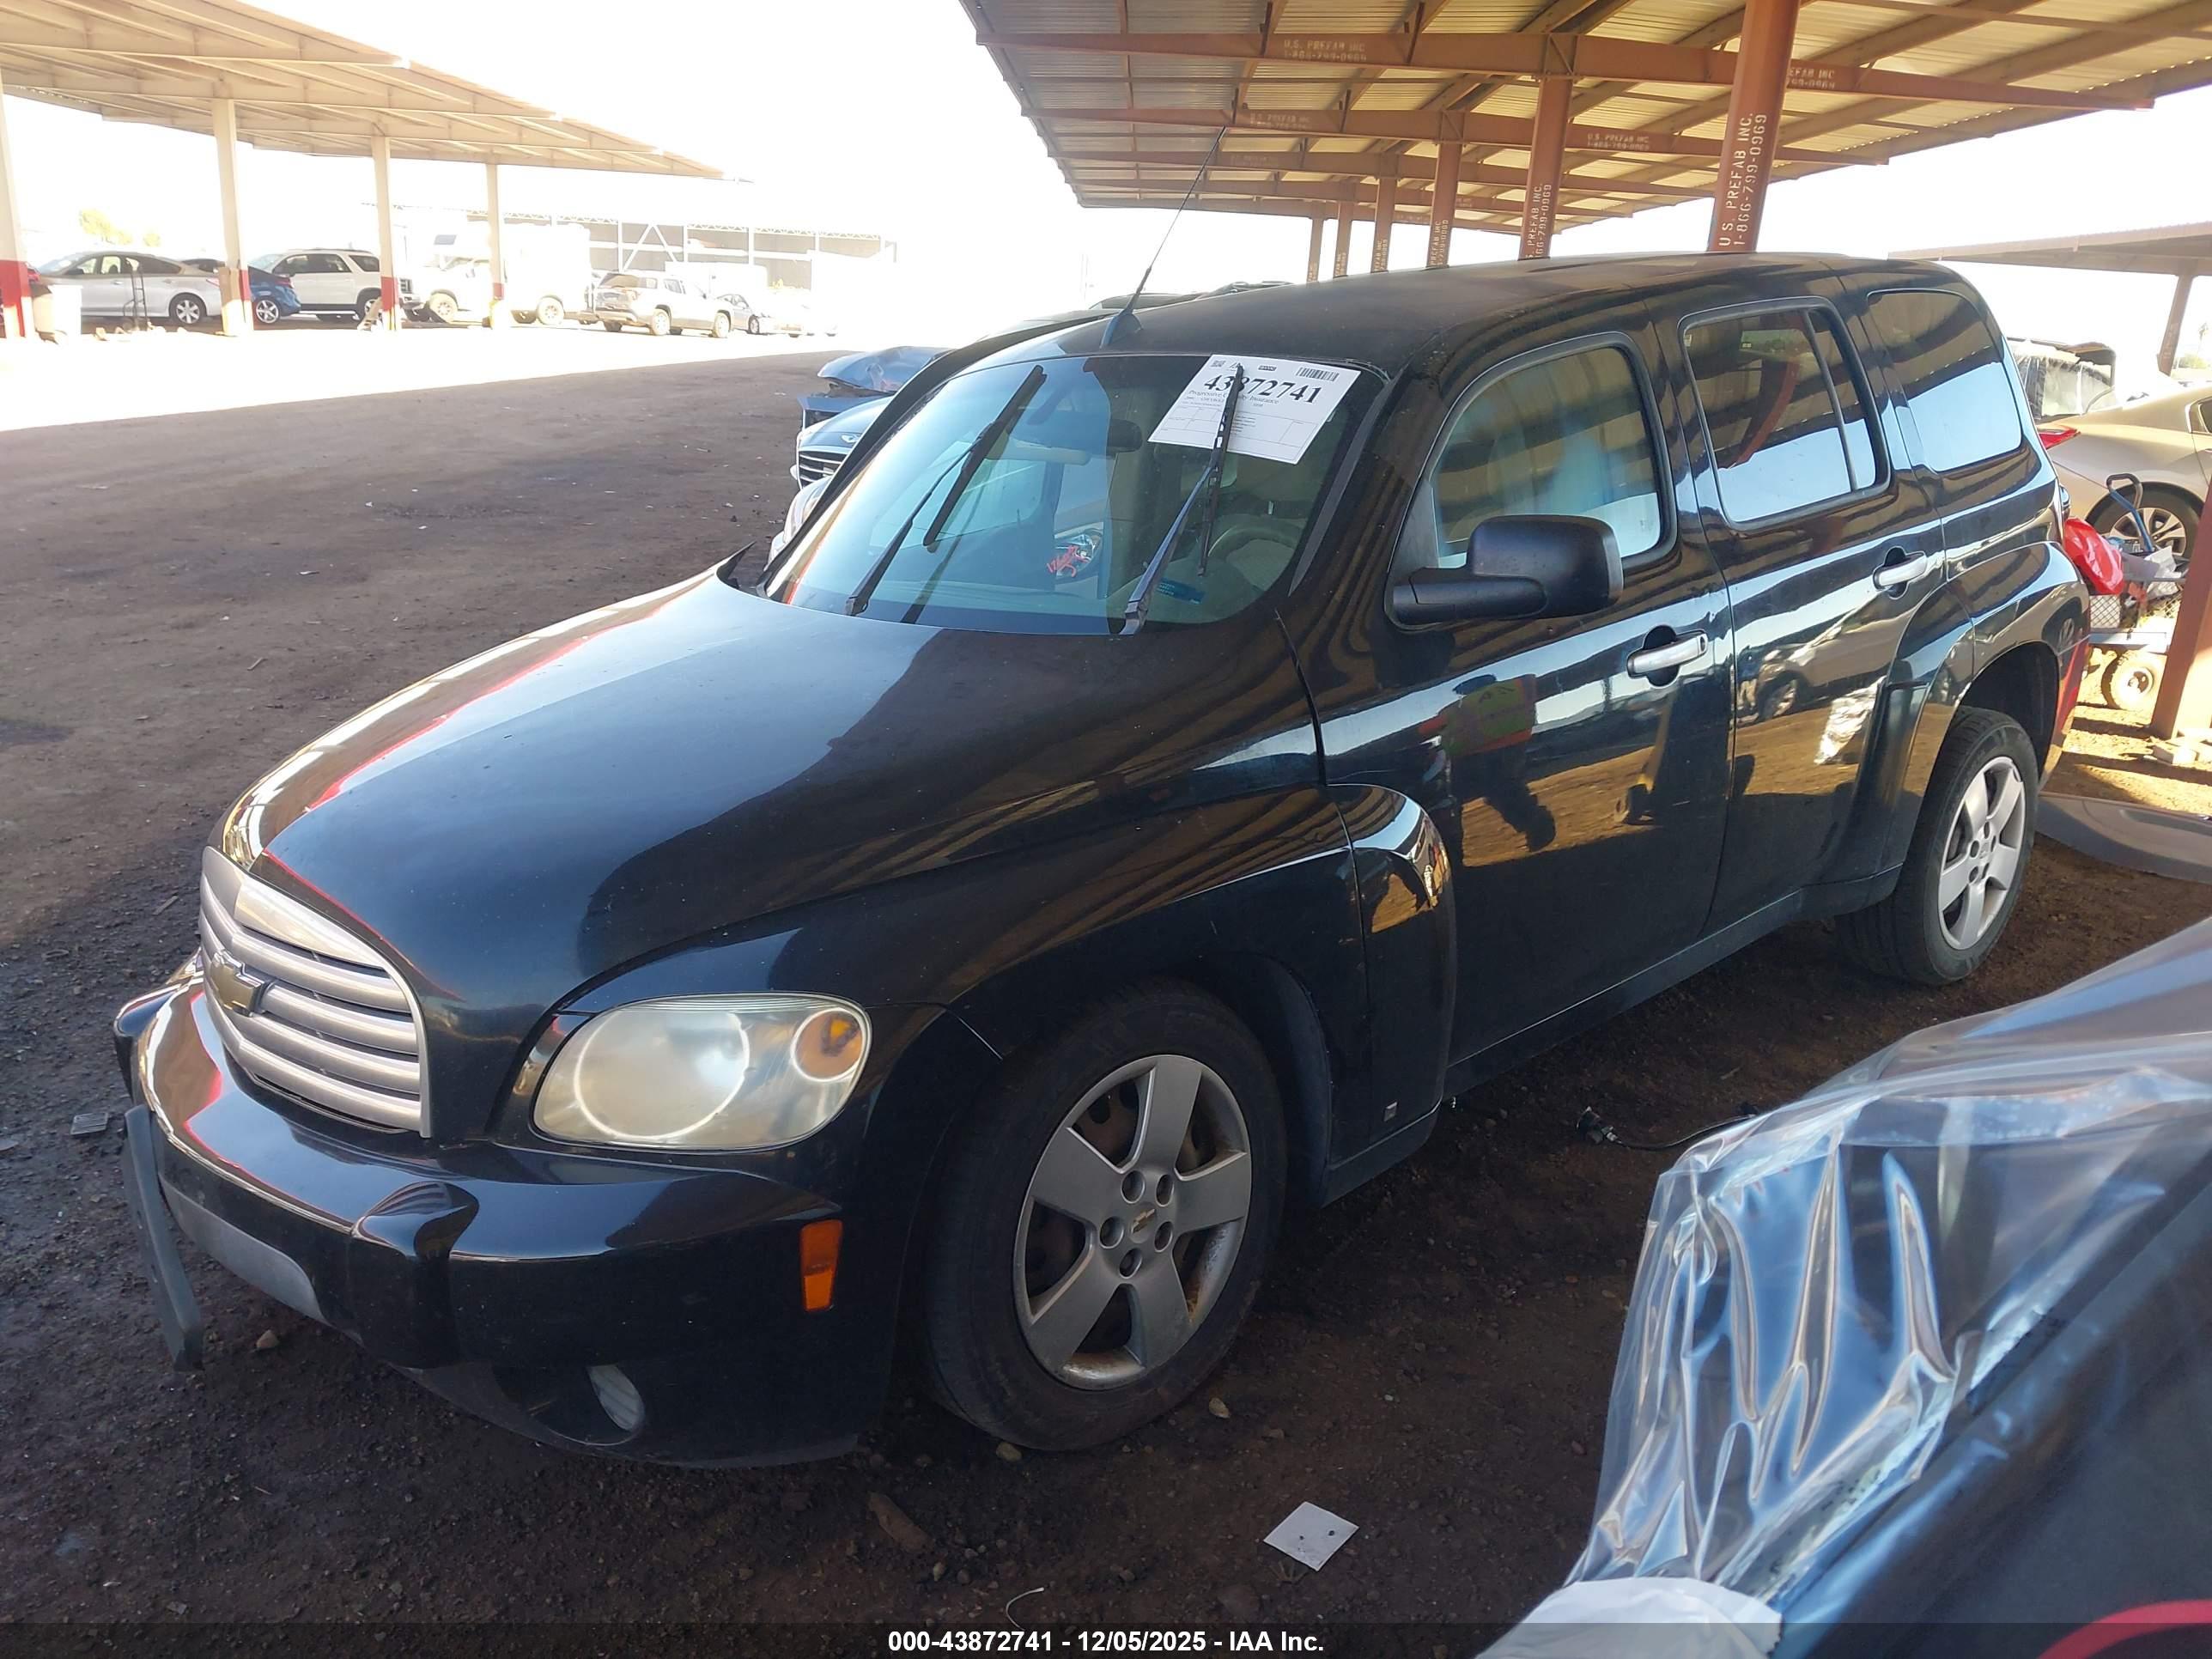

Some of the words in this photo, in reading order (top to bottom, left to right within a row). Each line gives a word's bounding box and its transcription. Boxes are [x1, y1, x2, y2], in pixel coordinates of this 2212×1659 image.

[1726, 150, 1747, 209] PREFAB
[1737, 113, 1753, 141] INC.
[1734, 114, 1767, 245] 1-866-799-0969
[1527, 207, 1540, 246] PREFAB
[1534, 185, 1552, 258] 66-799-0969
